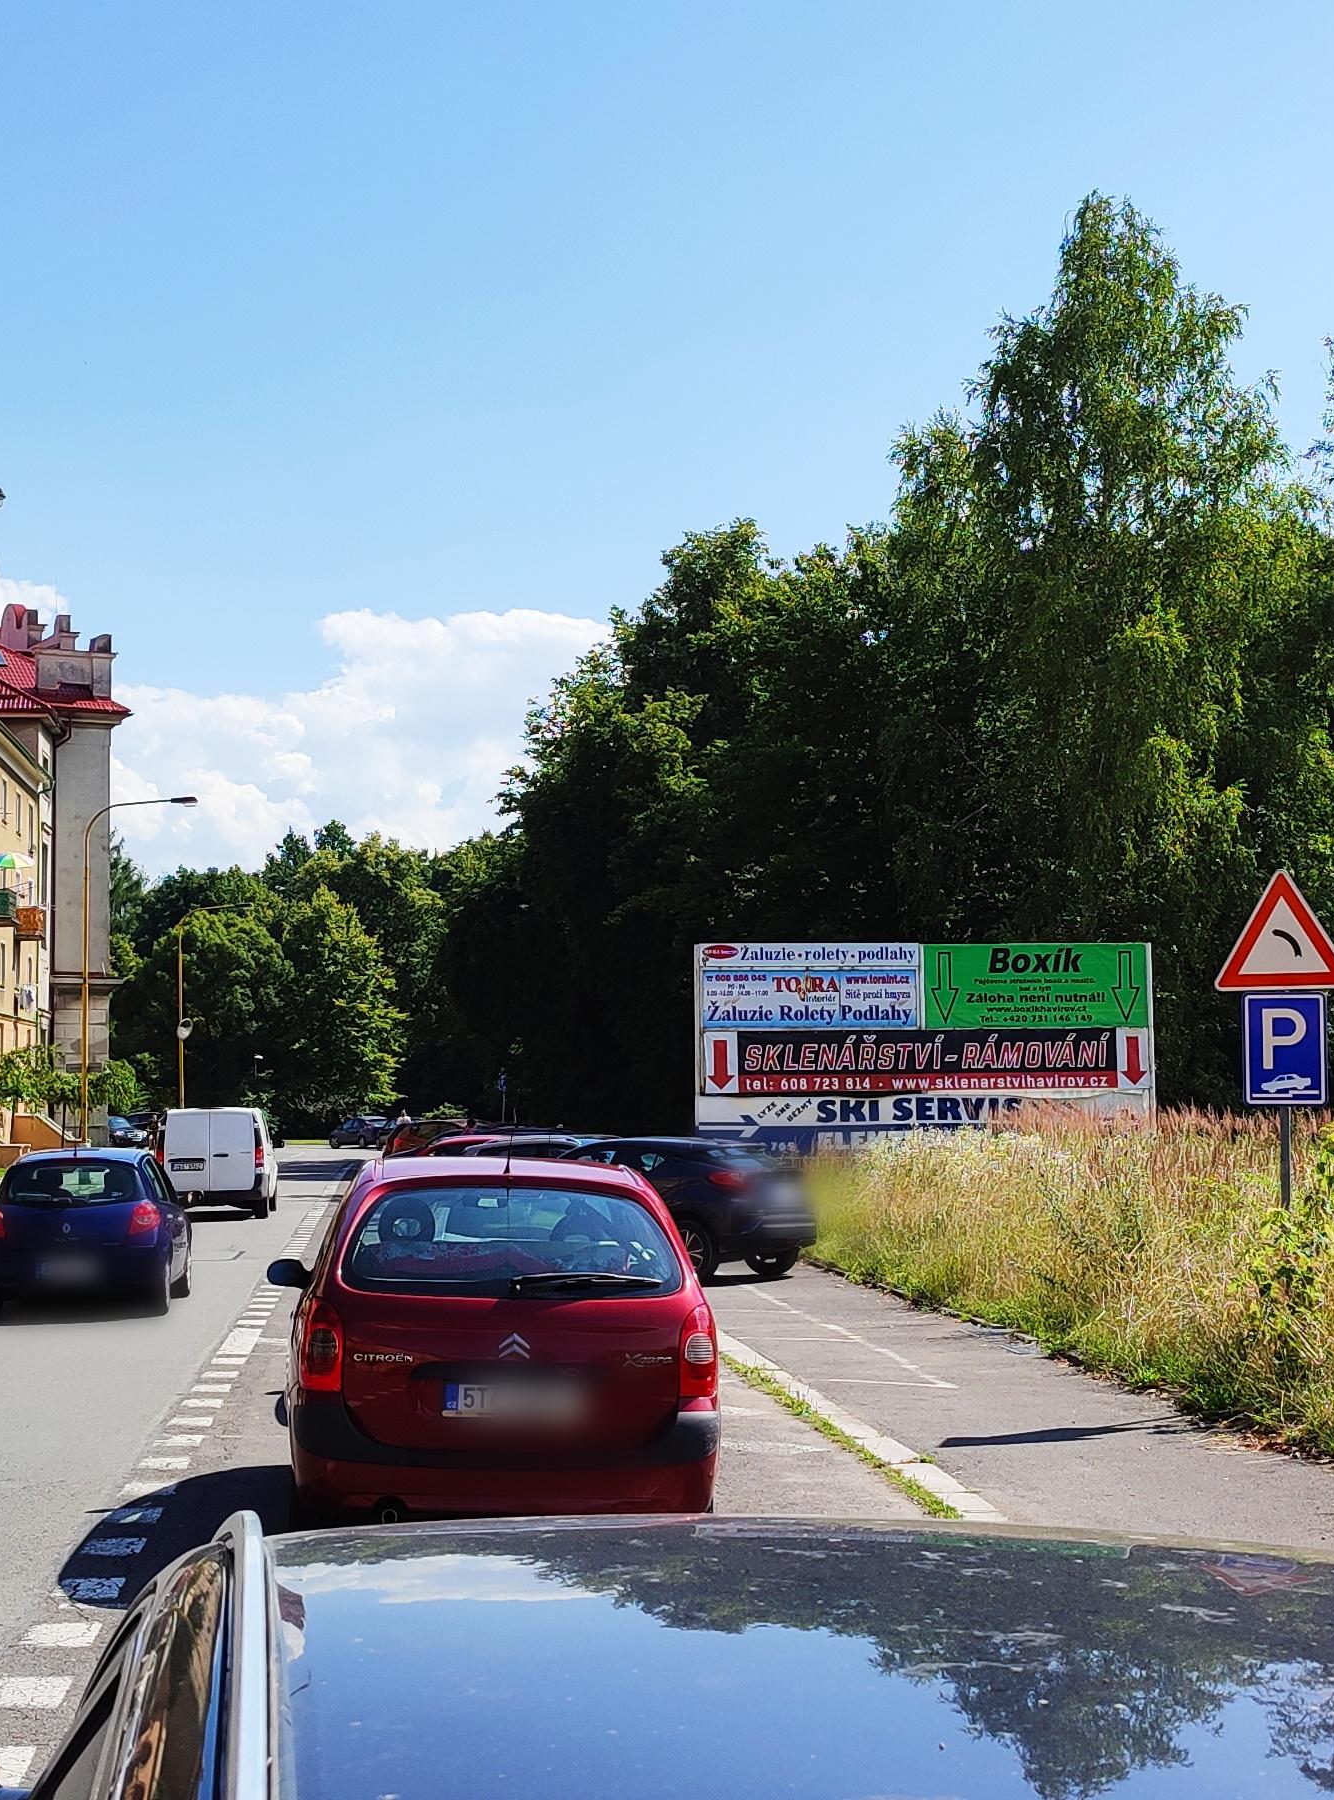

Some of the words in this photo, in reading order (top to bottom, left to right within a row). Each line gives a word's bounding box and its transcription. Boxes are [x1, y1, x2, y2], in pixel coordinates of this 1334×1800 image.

[740, 945, 796, 961] Žaluzie
[804, 946, 849, 964] rolety
[858, 946, 916, 964] podlahy
[988, 946, 1083, 974] Boxík
[966, 993, 1015, 1003] Záloha
[1019, 993, 1050, 1003] není
[1055, 992, 1106, 1002] nutná!!
[707, 1000, 773, 1022] Žaluzie
[779, 1004, 836, 1025] Rolety
[841, 1004, 912, 1025] Podlahy
[1031, 1015, 1047, 1023] 731
[1262, 1008, 1307, 1069] P
[745, 1077, 774, 1090] tel:
[780, 1078, 808, 1090] 608
[813, 1078, 839, 1090] 723
[845, 1077, 870, 1090] 814
[891, 1075, 1108, 1090] www.sklenarstvihavirov.cz
[816, 1098, 879, 1122] SKI
[353, 1352, 414, 1363] CITROËN
